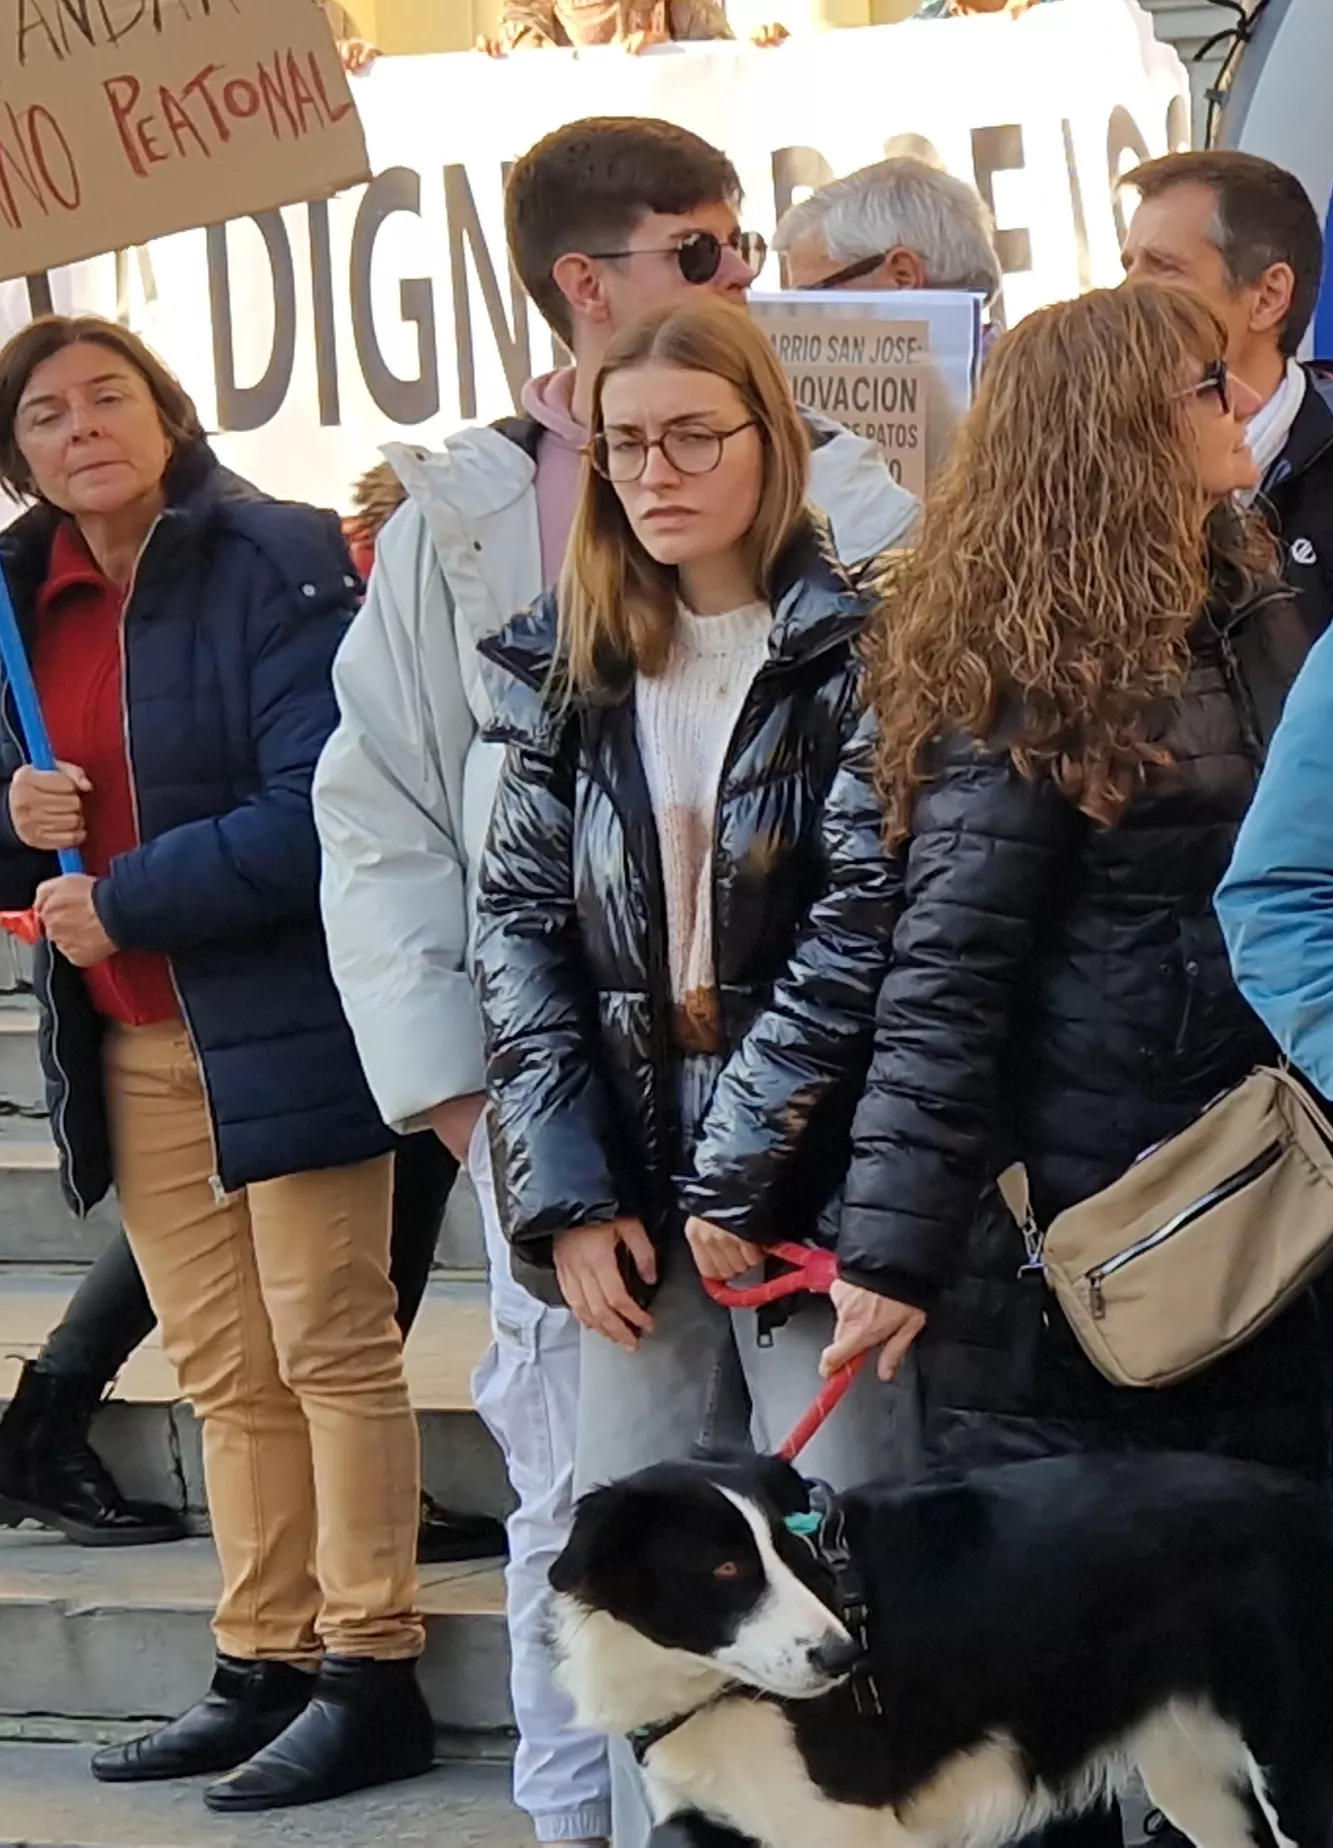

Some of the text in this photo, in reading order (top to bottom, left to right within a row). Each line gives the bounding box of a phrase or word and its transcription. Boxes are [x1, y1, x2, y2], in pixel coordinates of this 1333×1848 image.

[102, 46, 354, 178] PEATONAL
[770, 334, 822, 363] ARRIO
[827, 335, 866, 364] SAN
